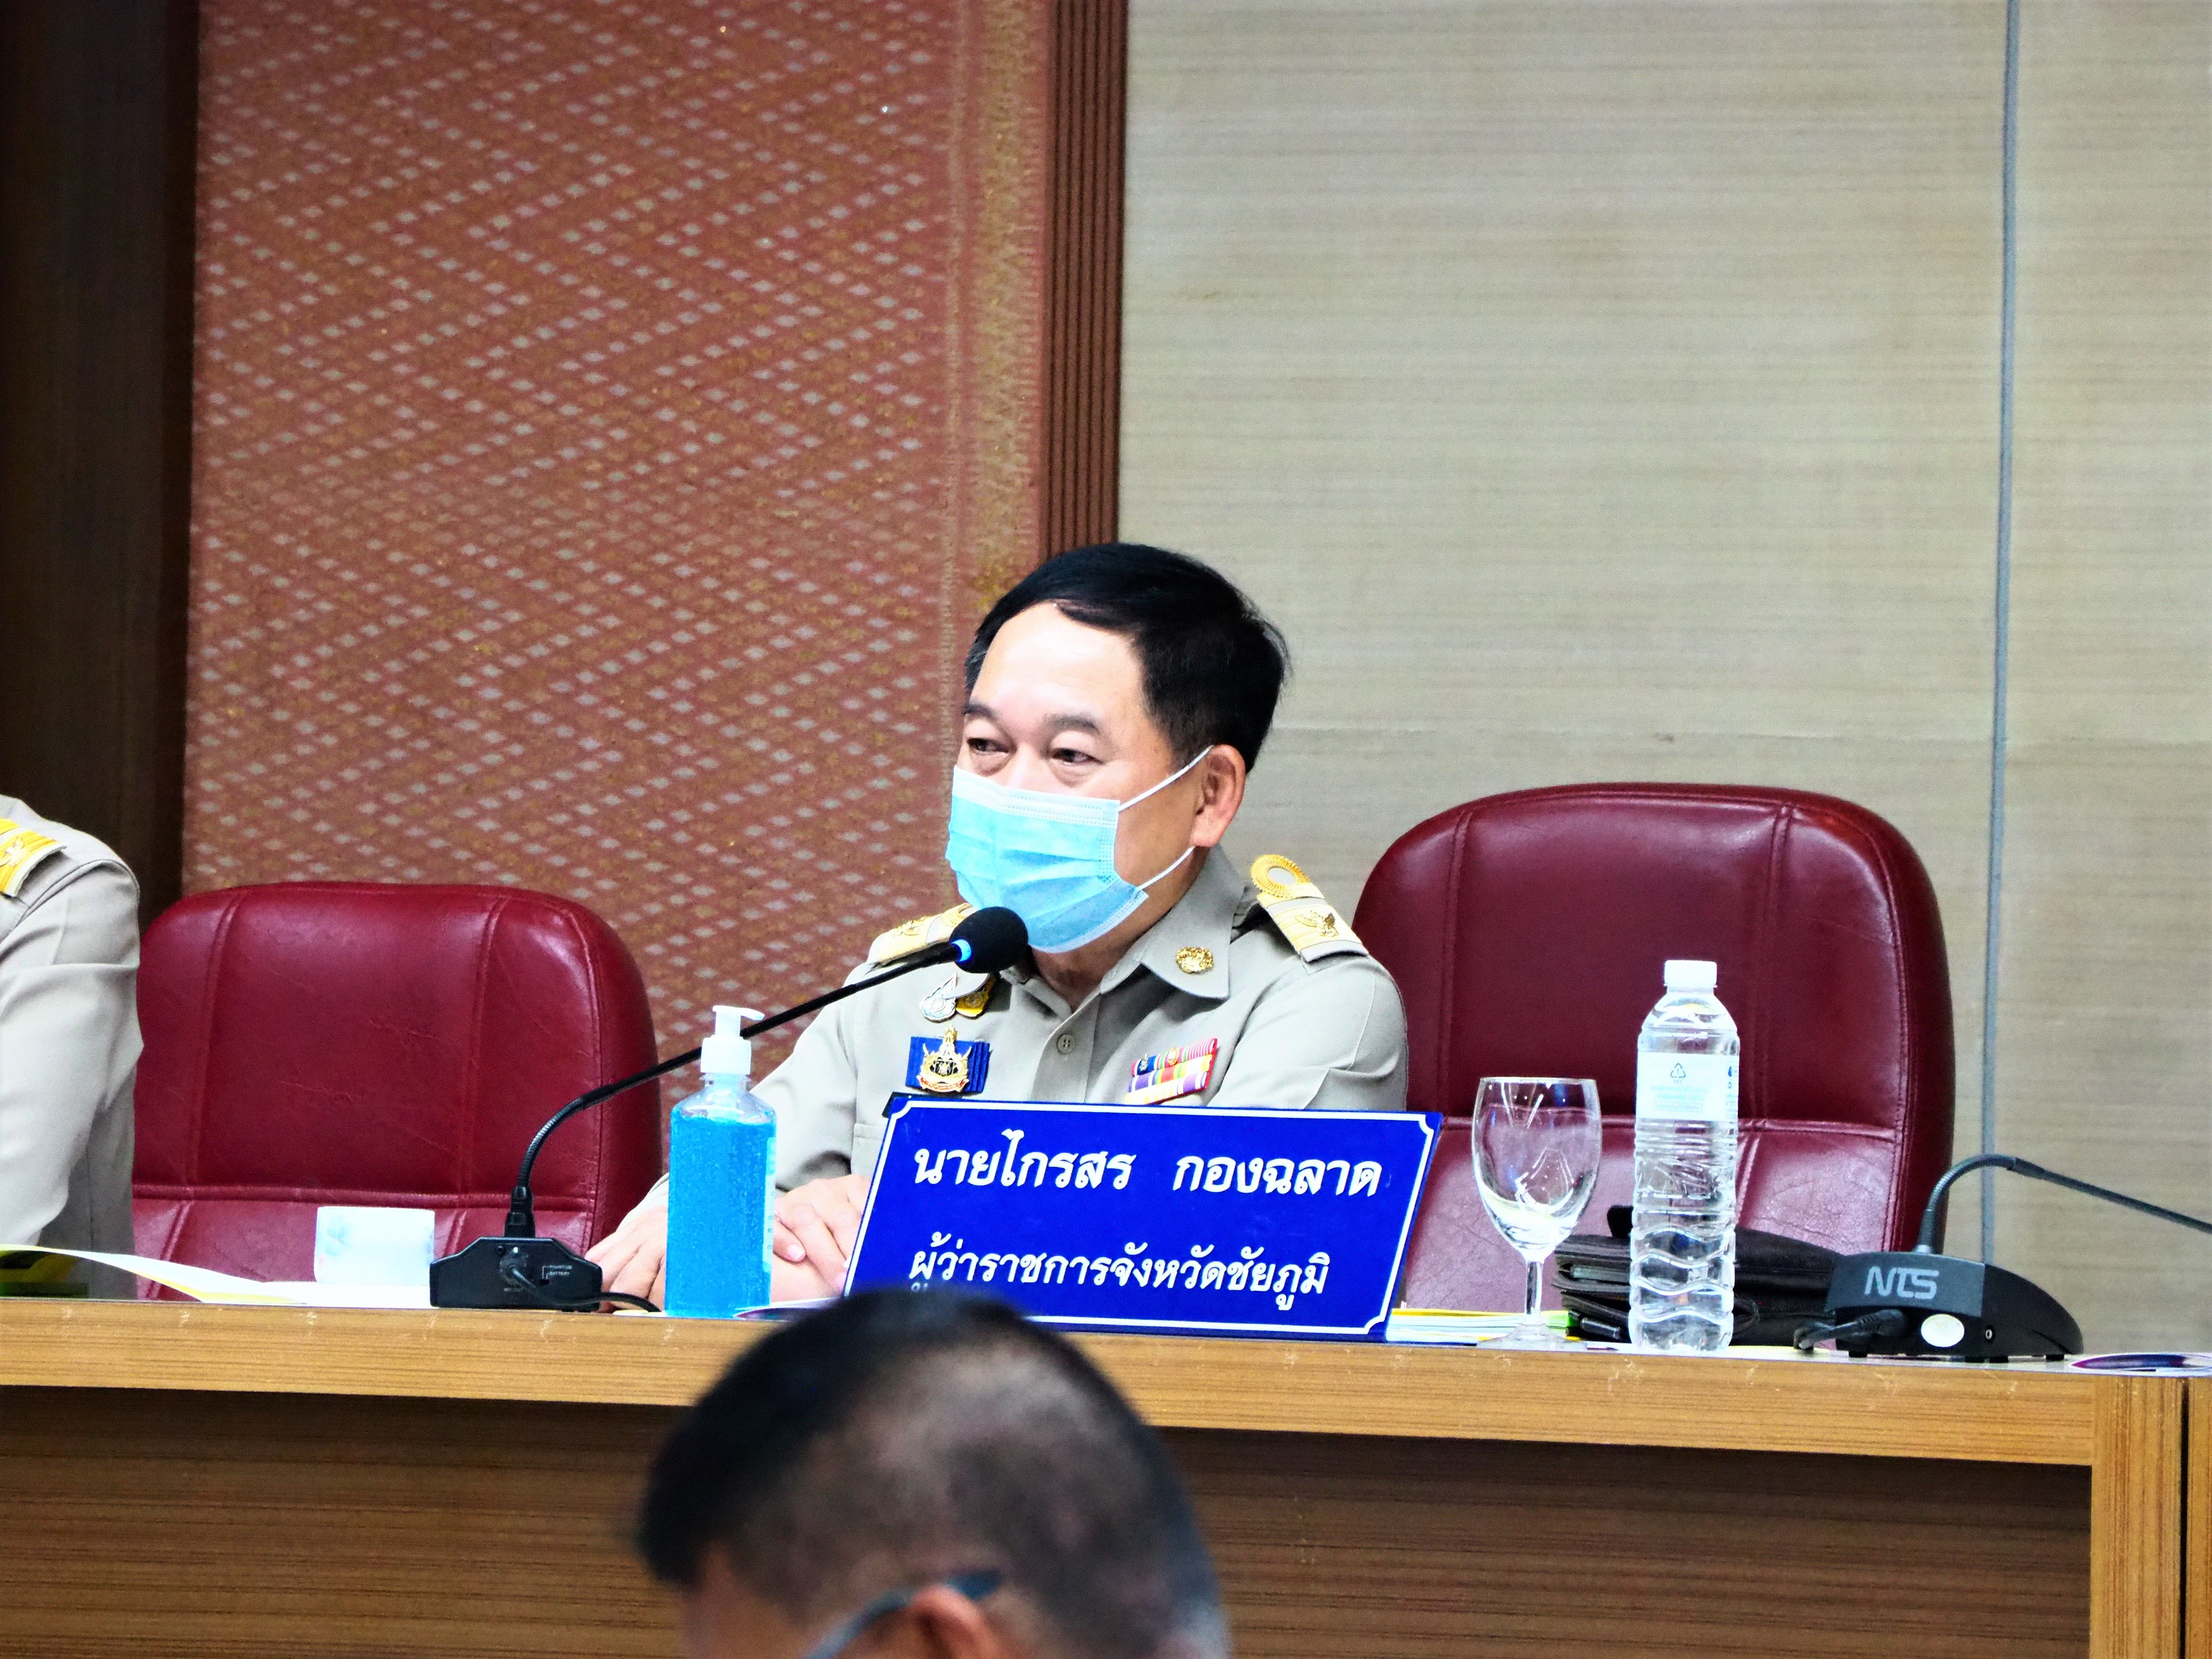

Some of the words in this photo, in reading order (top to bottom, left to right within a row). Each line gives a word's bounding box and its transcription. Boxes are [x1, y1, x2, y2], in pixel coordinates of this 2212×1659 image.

[914, 1129, 1137, 1190] นายไกรสร
[1173, 1155, 1382, 1197] กองฉลาด
[909, 1231, 1330, 1310] ผู้ว่าราชการจังหวัดชัยภูมิ
[1864, 1266, 1939, 1299] NTS
